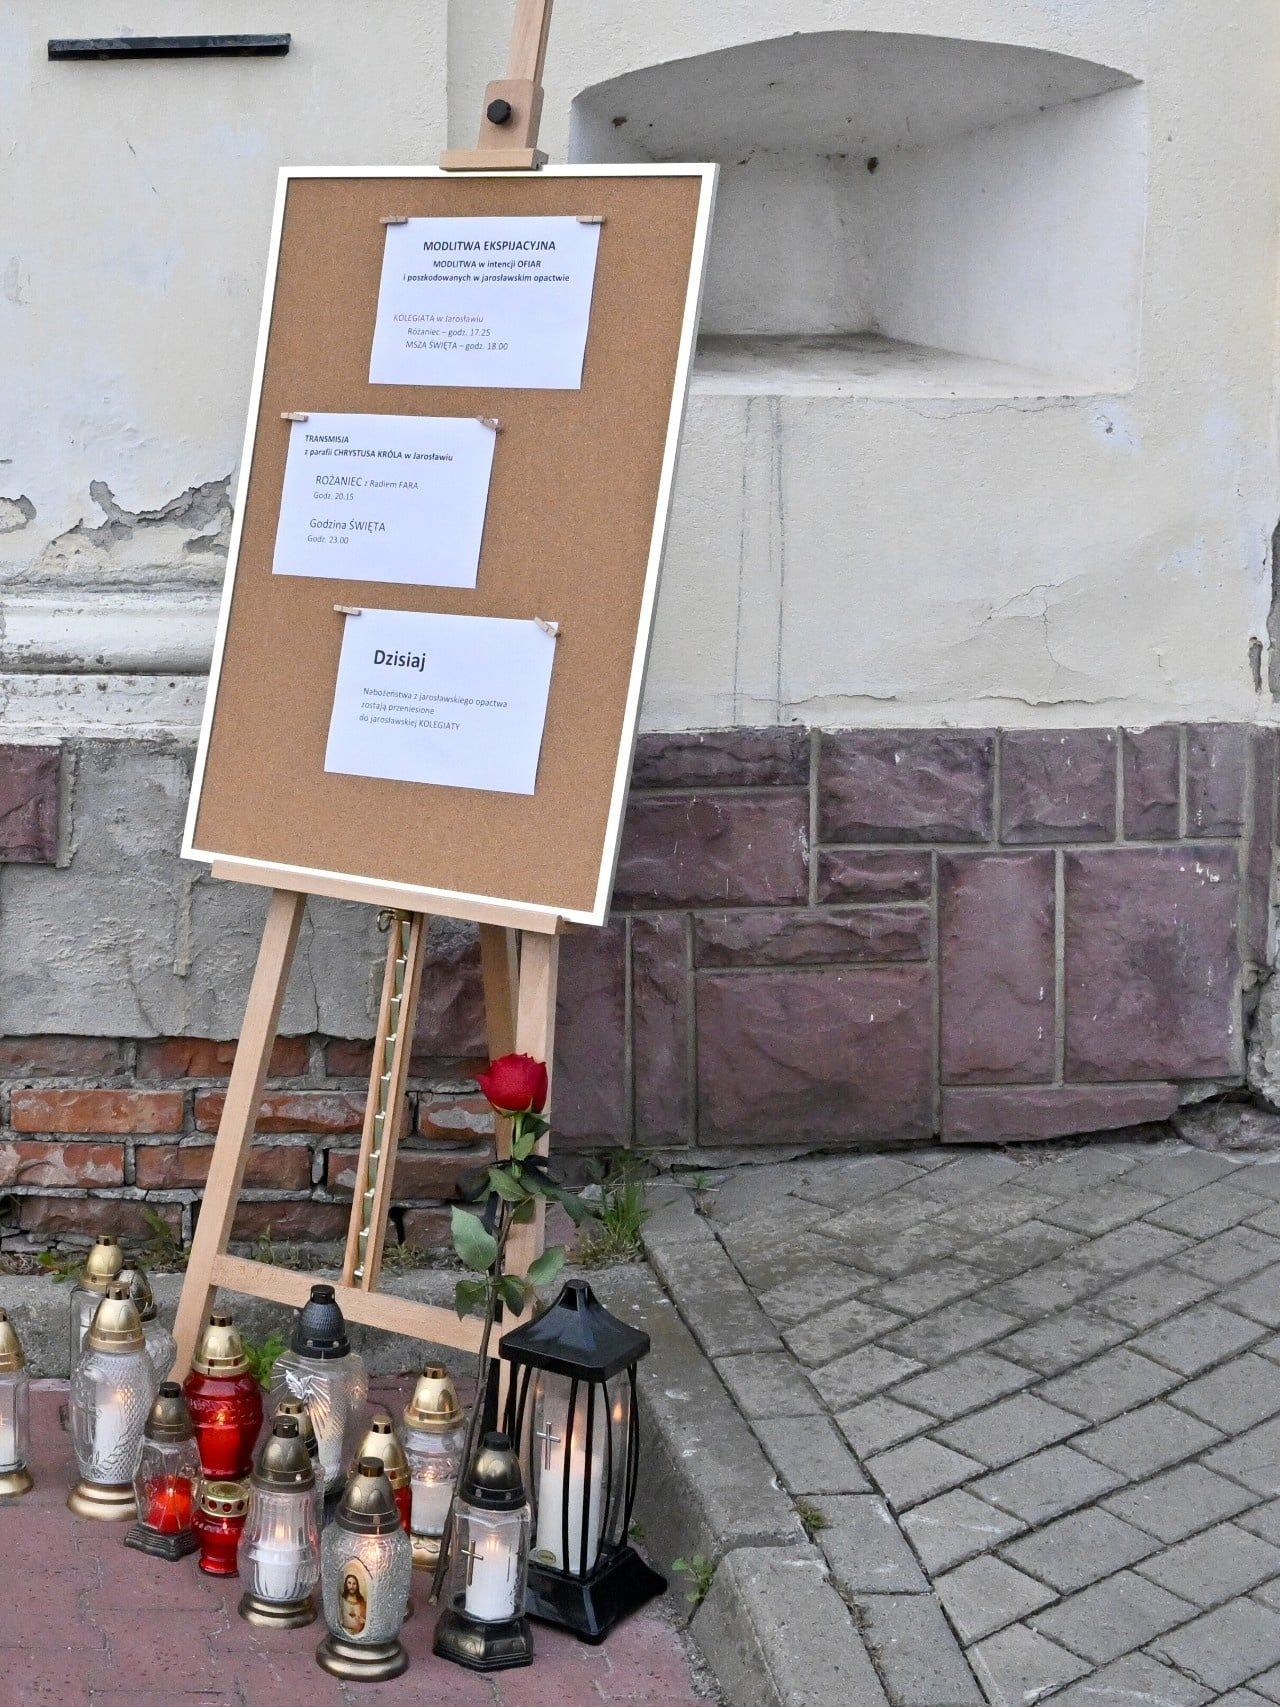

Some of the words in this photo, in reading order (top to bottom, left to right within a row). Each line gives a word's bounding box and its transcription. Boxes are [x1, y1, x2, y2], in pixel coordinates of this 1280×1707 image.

[424, 242, 480, 251] MODLITWA
[484, 241, 556, 251] EKSPIJACYJNA
[433, 260, 476, 268] MODLITWA
[487, 260, 516, 270] intencji
[517, 260, 542, 268] OFIAR
[407, 274, 471, 283] poszkodowanych
[481, 274, 532, 283] jarosławskim
[534, 274, 570, 283] opactwie
[445, 315, 484, 323] Jarosławiu
[408, 328, 440, 336] Różaniec
[448, 328, 468, 337] godz.
[470, 328, 491, 336] 17.25
[428, 340, 458, 350] ŚWIĘTA
[465, 342, 484, 351] godz.
[487, 342, 508, 350] 18.00
[304, 434, 349, 443] TRANSMISJA
[310, 448, 333, 457] parafii
[334, 449, 376, 458] CHRYSTUSA
[378, 449, 402, 458] KRÓLA
[413, 452, 454, 462] Jarosławiu
[370, 480, 397, 489] Radiem
[398, 481, 418, 490] FARA
[314, 492, 332, 500] Godz.
[334, 492, 354, 501] 20.15
[310, 518, 347, 530] Godzina
[349, 518, 386, 534] ŚWIĘTA
[307, 534, 326, 543] Godz.
[328, 536, 348, 544] 23.00
[374, 650, 426, 672] Dzisiaj
[363, 688, 412, 700] Nabożeństwa
[419, 693, 474, 706] jarosławskiego
[475, 698, 508, 708] opactwa
[361, 702, 387, 712] zostają
[388, 704, 435, 715] przeniesione
[359, 714, 368, 722] do
[370, 714, 418, 728] jarosławskiej
[418, 720, 460, 730] KOLEGIATY
